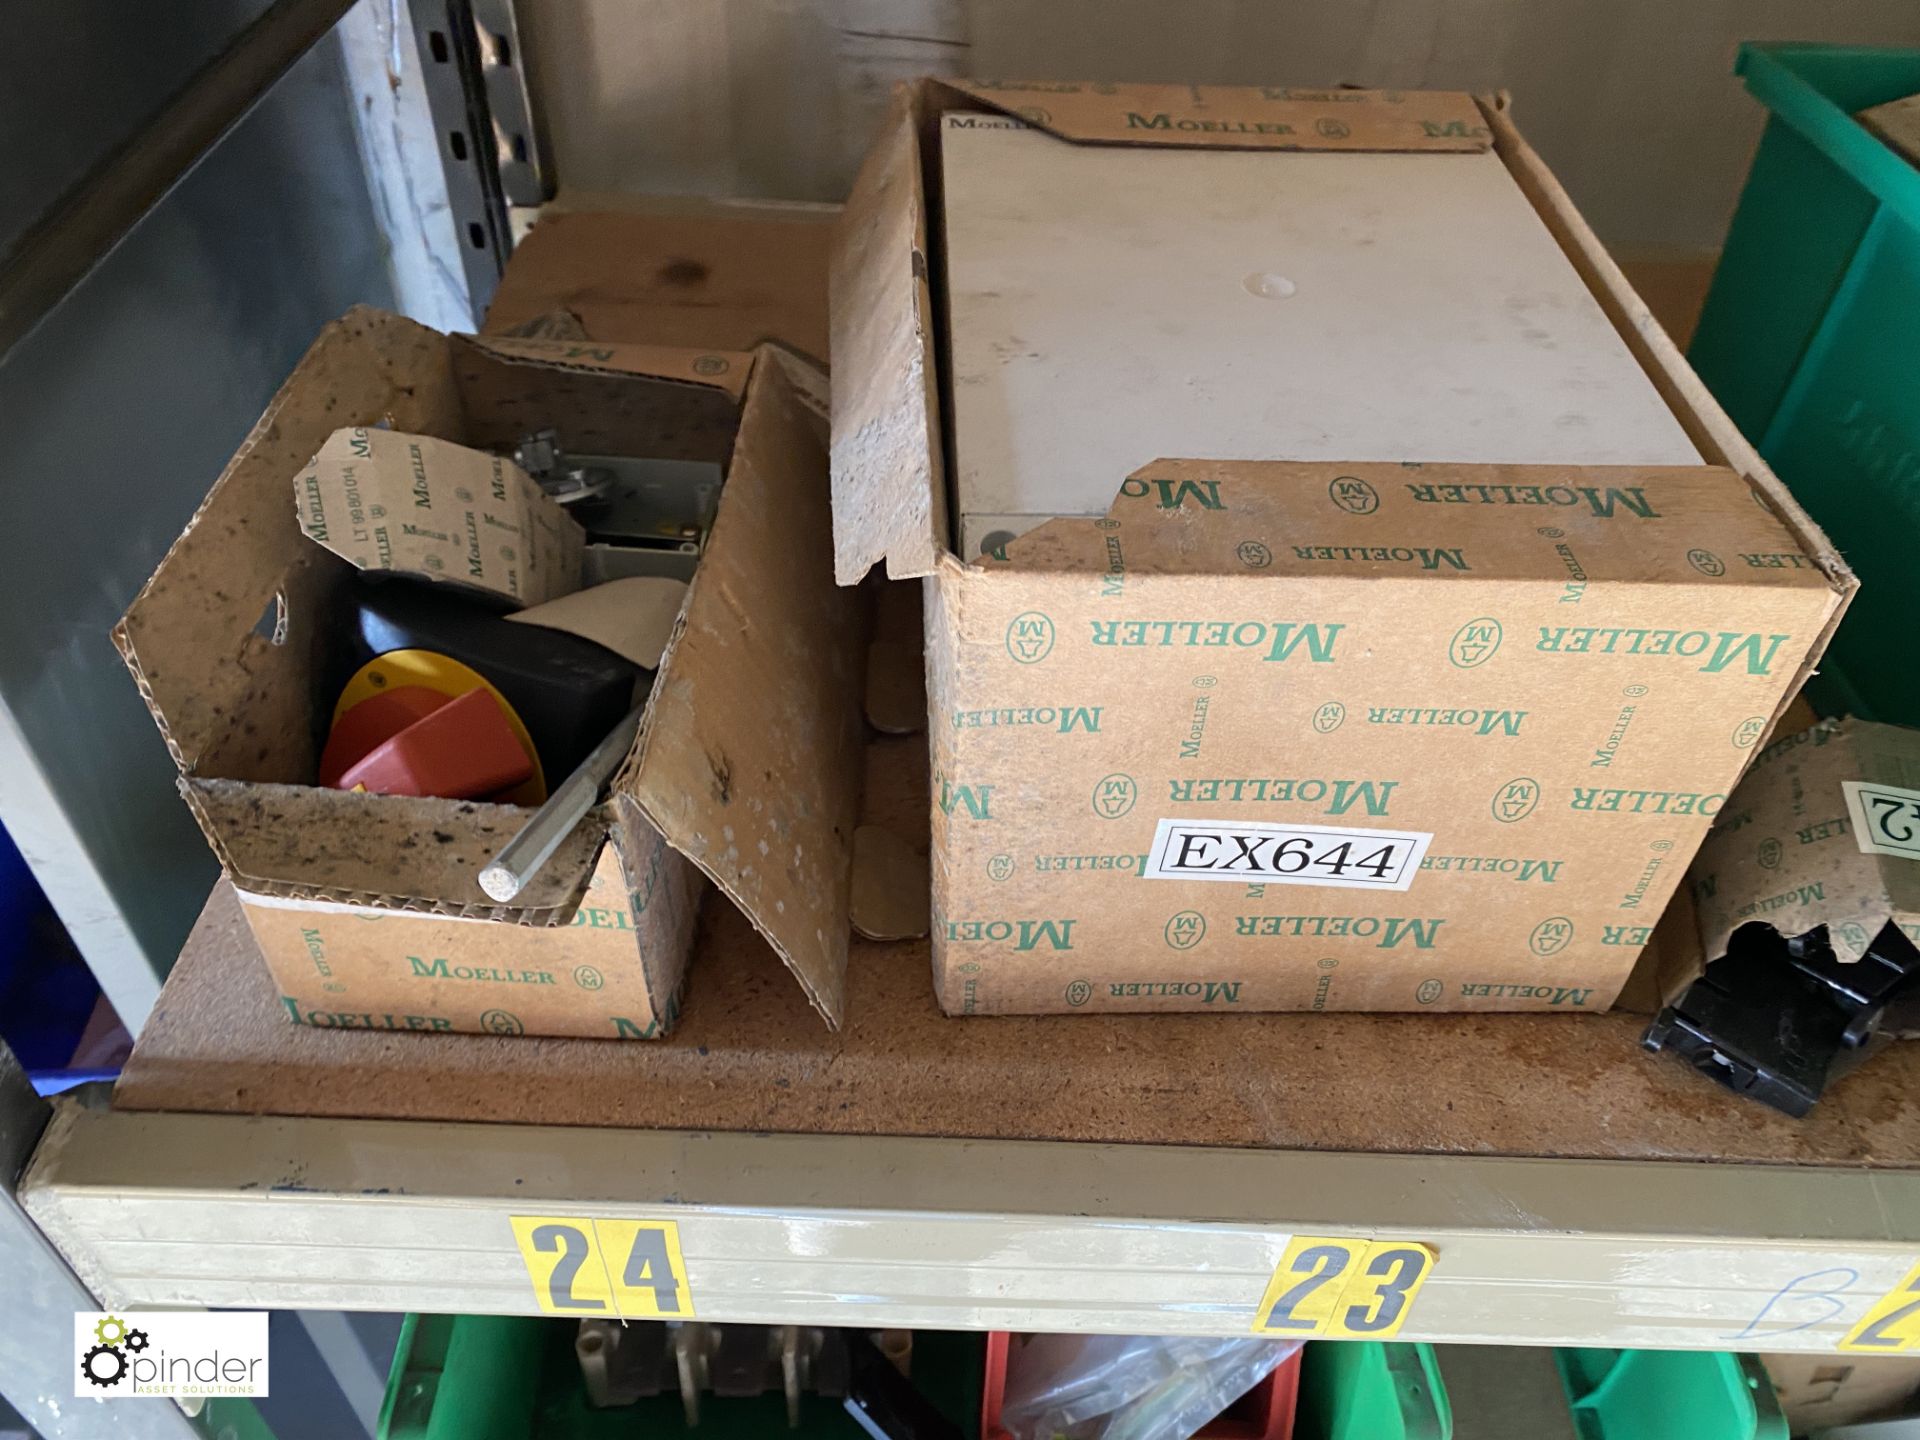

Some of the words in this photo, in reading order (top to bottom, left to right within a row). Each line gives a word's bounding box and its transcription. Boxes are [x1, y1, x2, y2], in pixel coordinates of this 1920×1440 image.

[1404, 483, 1663, 518] MOELLER
[1291, 545, 1473, 571] MOELLER
[1090, 620, 1347, 663] MOELLER
[1535, 626, 1792, 676] MOELLER
[1367, 707, 1529, 737] MOELLER
[1168, 778, 1400, 817] MOELLER
[1871, 797, 1920, 843] 2
[1170, 833, 1397, 878] EX644
[1235, 916, 1447, 950] MOELLER
[406, 955, 557, 985] MOELLER
[1109, 981, 1243, 1004] MOELLER
[1460, 983, 1595, 1006] MOELLER
[531, 1224, 681, 1313] 24
[1264, 1245, 1426, 1332] 23
